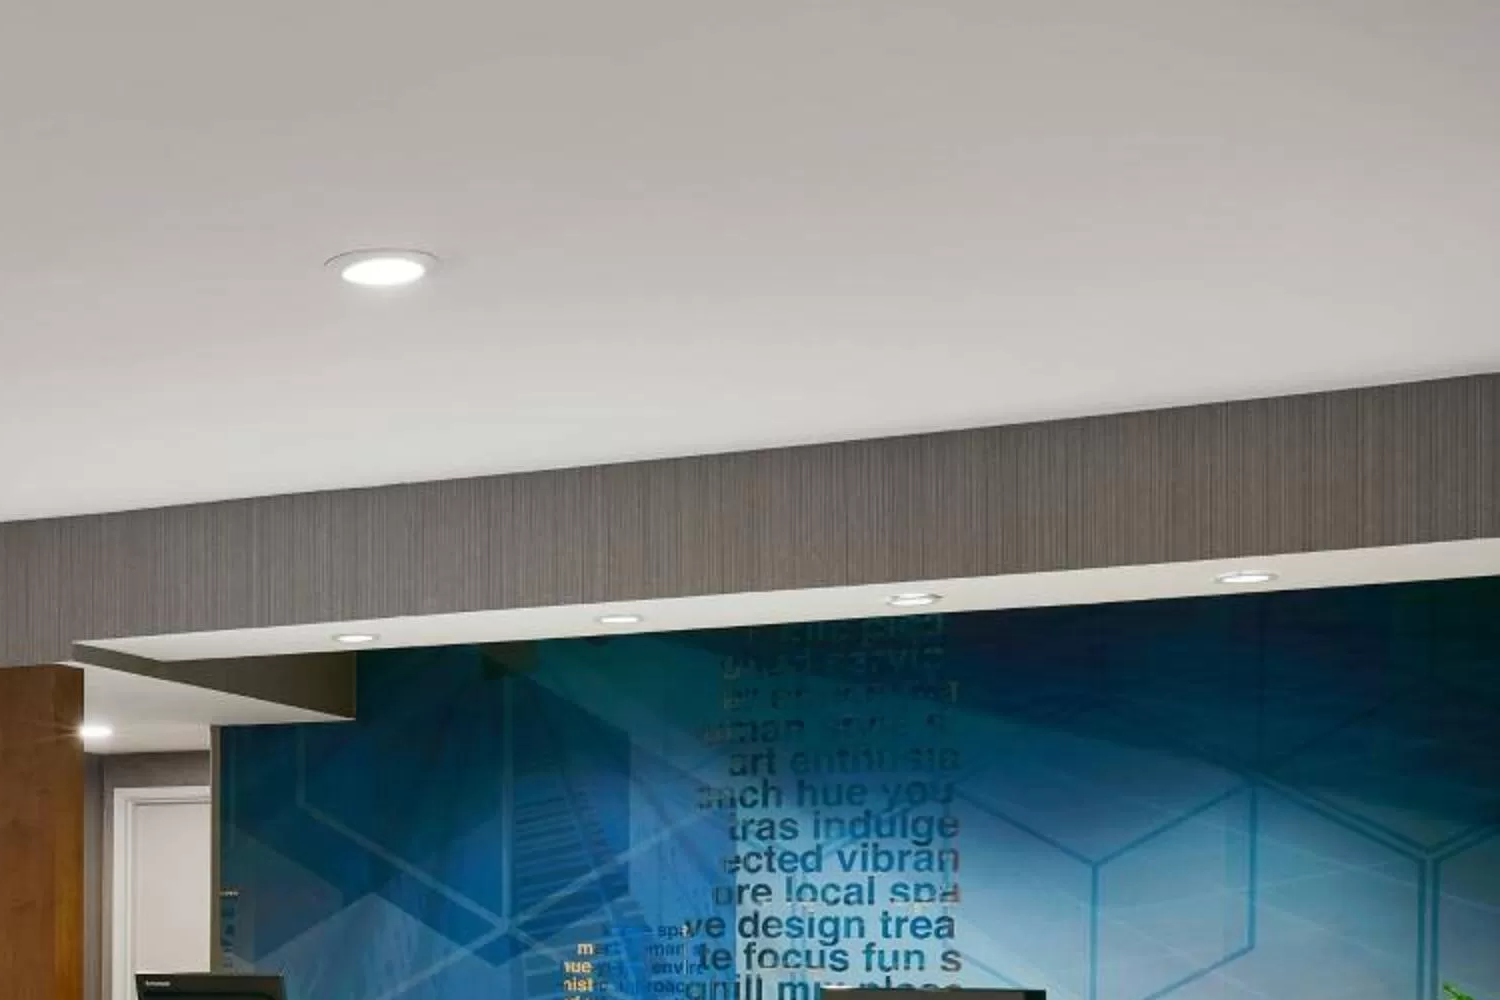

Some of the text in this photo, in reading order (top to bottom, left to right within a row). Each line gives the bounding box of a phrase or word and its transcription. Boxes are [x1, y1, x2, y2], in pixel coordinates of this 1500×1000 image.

[798, 778, 869, 808] hue
[812, 810, 960, 847] indulge
[836, 842, 960, 874] vibran
[785, 875, 875, 905] local
[737, 909, 866, 947] design
[880, 910, 956, 939] trea
[742, 941, 850, 973] focus
[862, 941, 926, 973] fun
[940, 948, 963, 973] s
